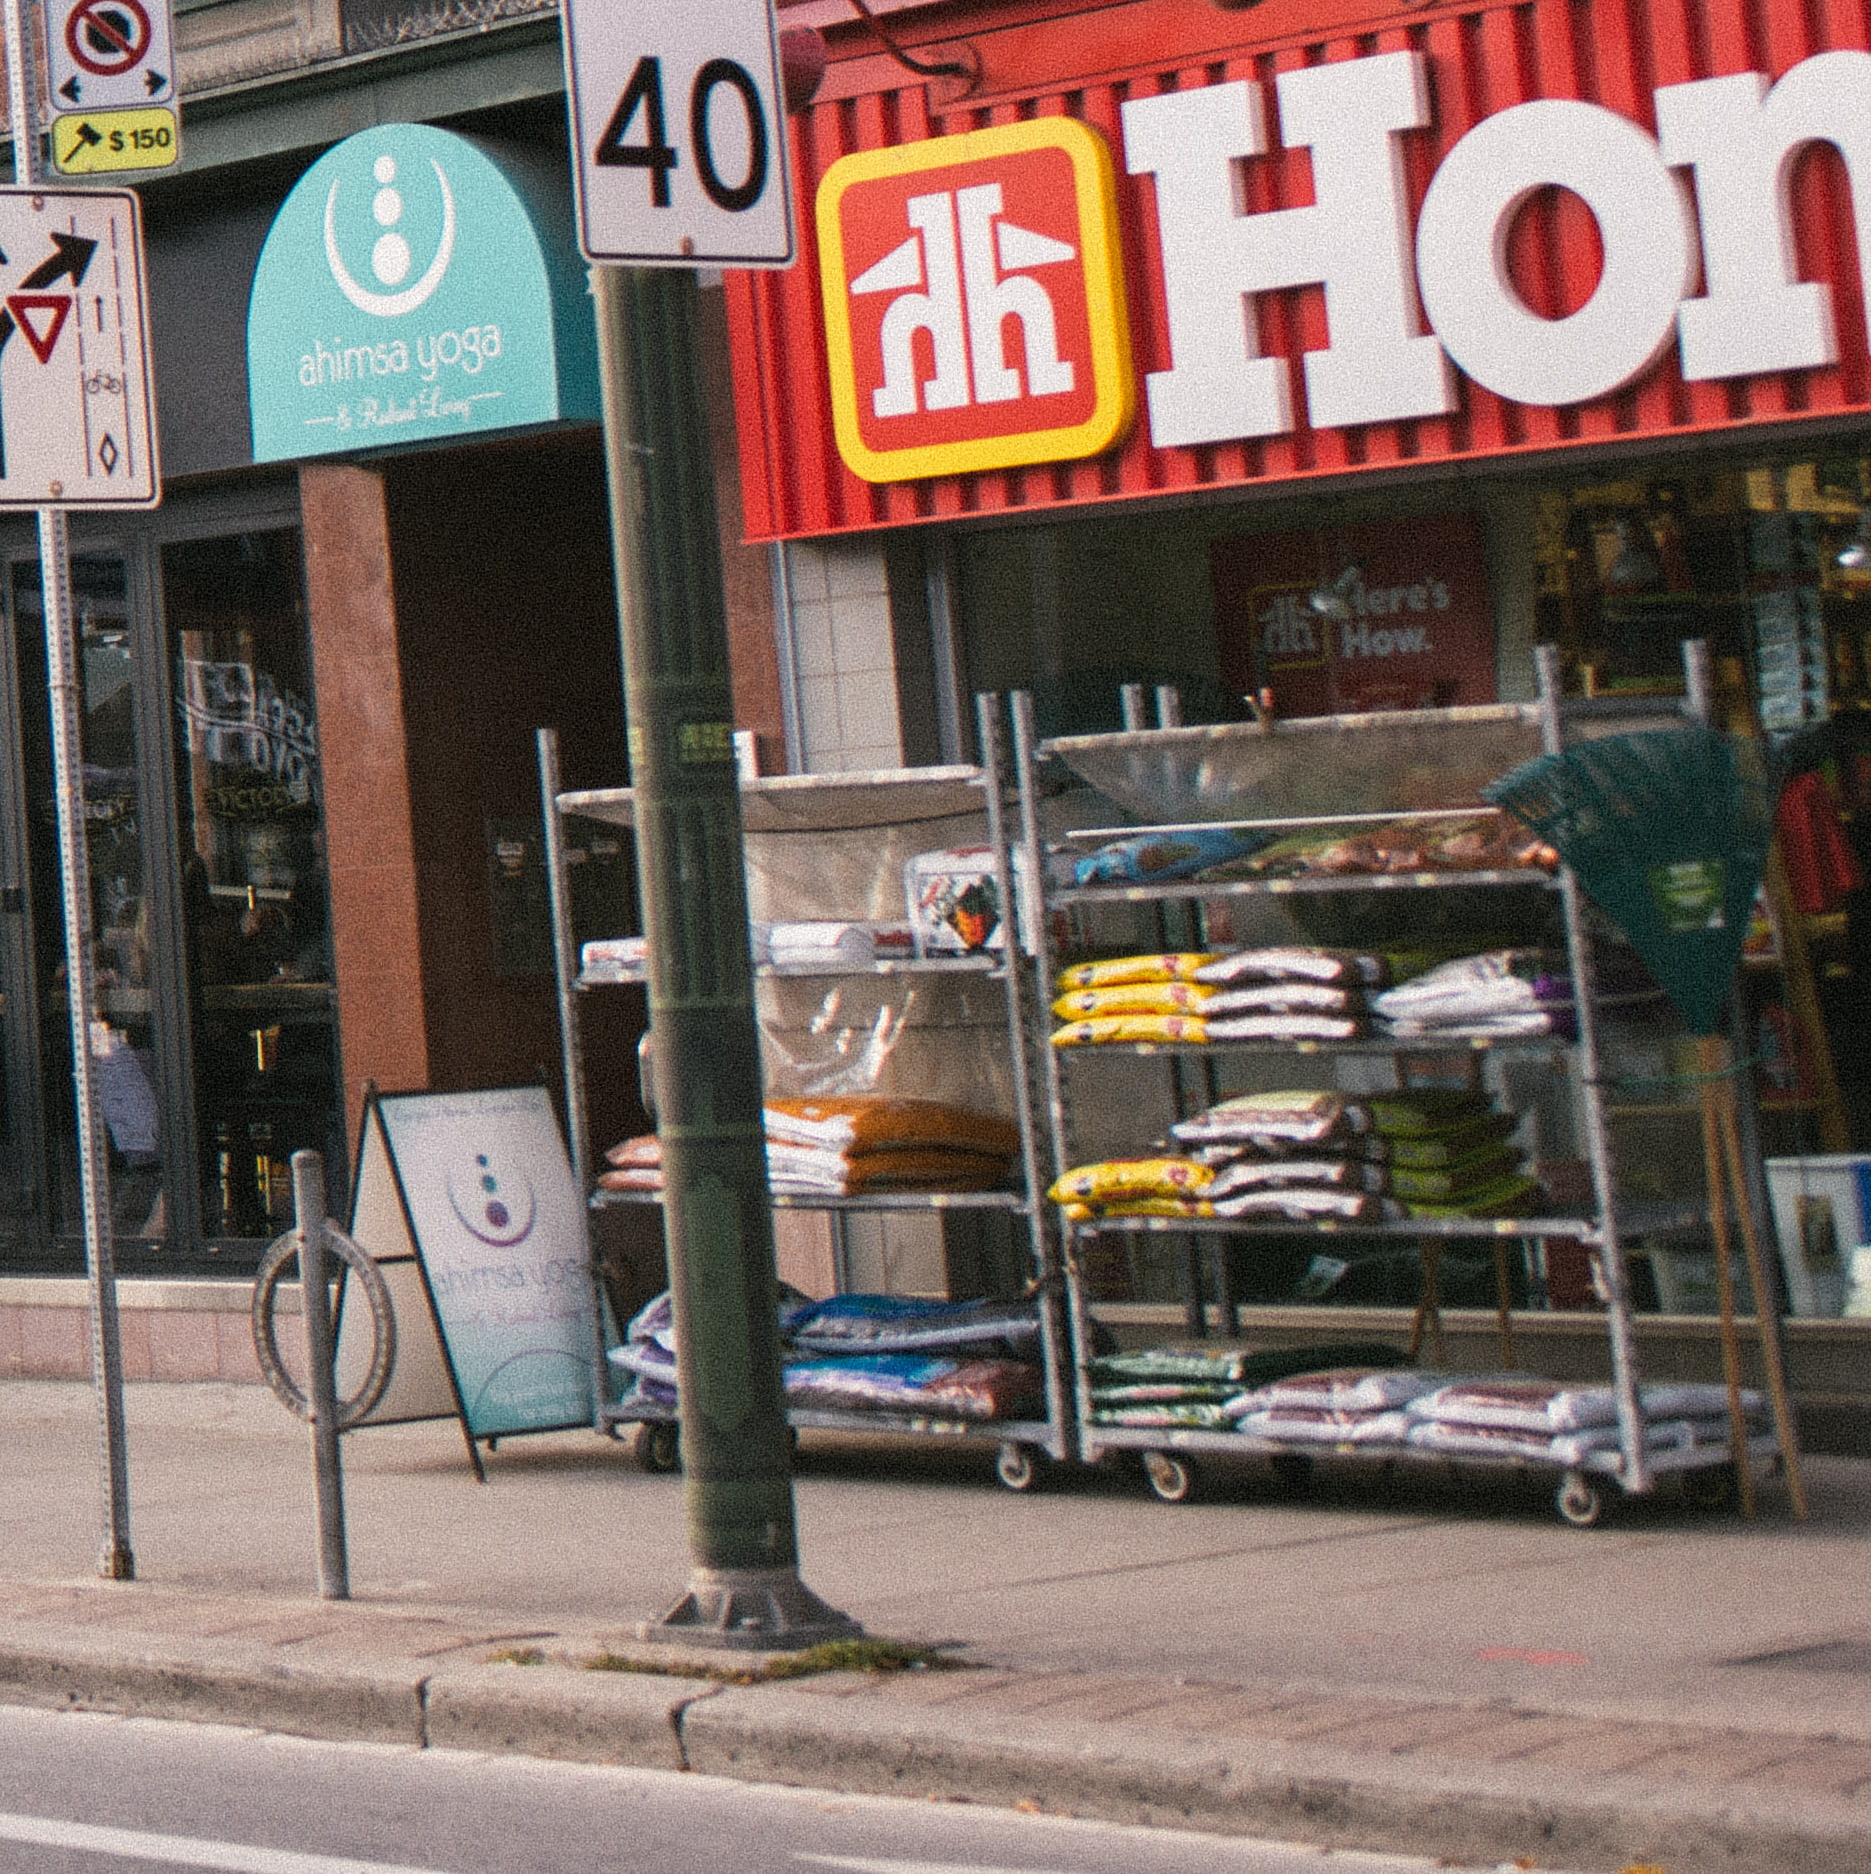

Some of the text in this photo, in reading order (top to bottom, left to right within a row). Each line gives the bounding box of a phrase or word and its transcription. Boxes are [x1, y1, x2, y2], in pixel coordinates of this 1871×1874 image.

[129, 127, 171, 149] 150
[593, 55, 770, 213] 40
[298, 324, 504, 387] ahimsa yoga
[528, 1258, 586, 1295] yog
